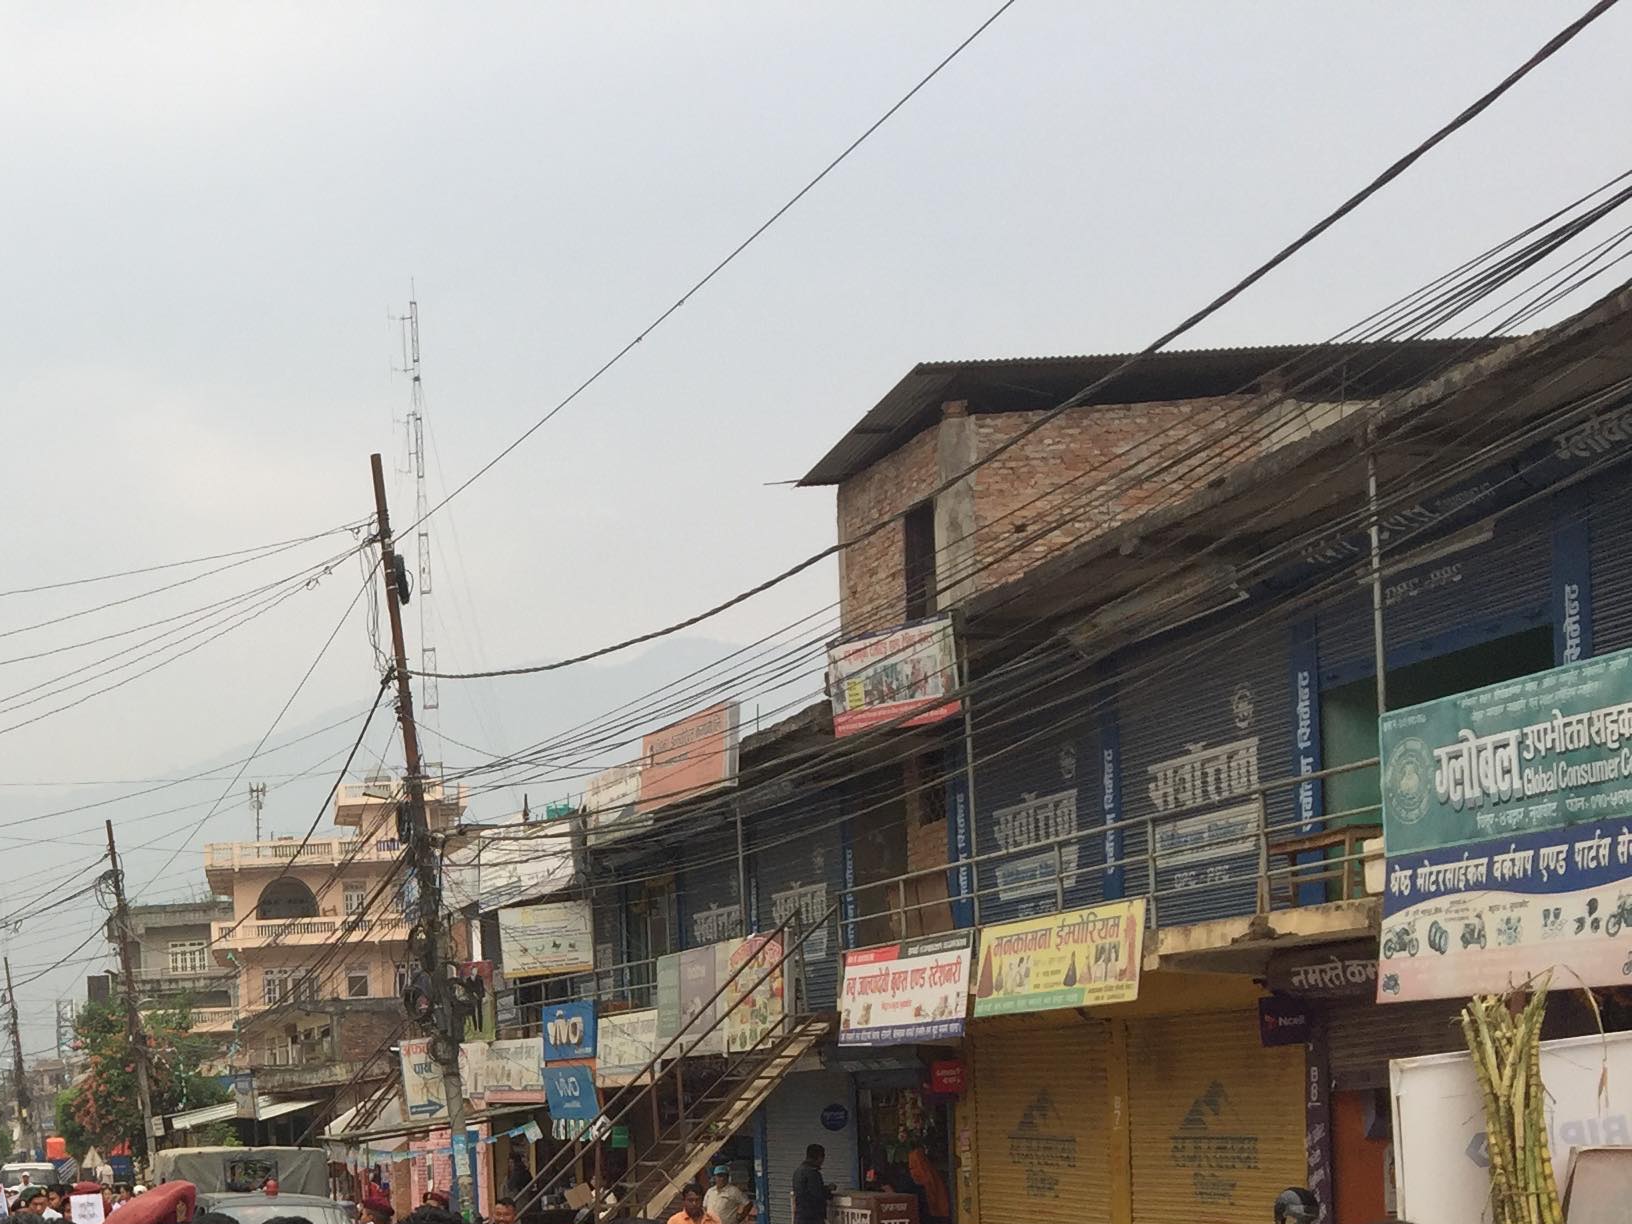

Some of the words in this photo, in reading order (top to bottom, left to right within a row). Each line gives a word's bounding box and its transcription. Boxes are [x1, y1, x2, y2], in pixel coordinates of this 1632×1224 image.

[1434, 729, 1523, 804] ग्लोबल
[1524, 762, 1557, 797] Global
[1558, 756, 1619, 790] Consumer
[1539, 845, 1568, 882] एण्ड
[993, 927, 1053, 957] मनकामना
[546, 1009, 584, 1048] vivo
[555, 1072, 580, 1098] vivo
